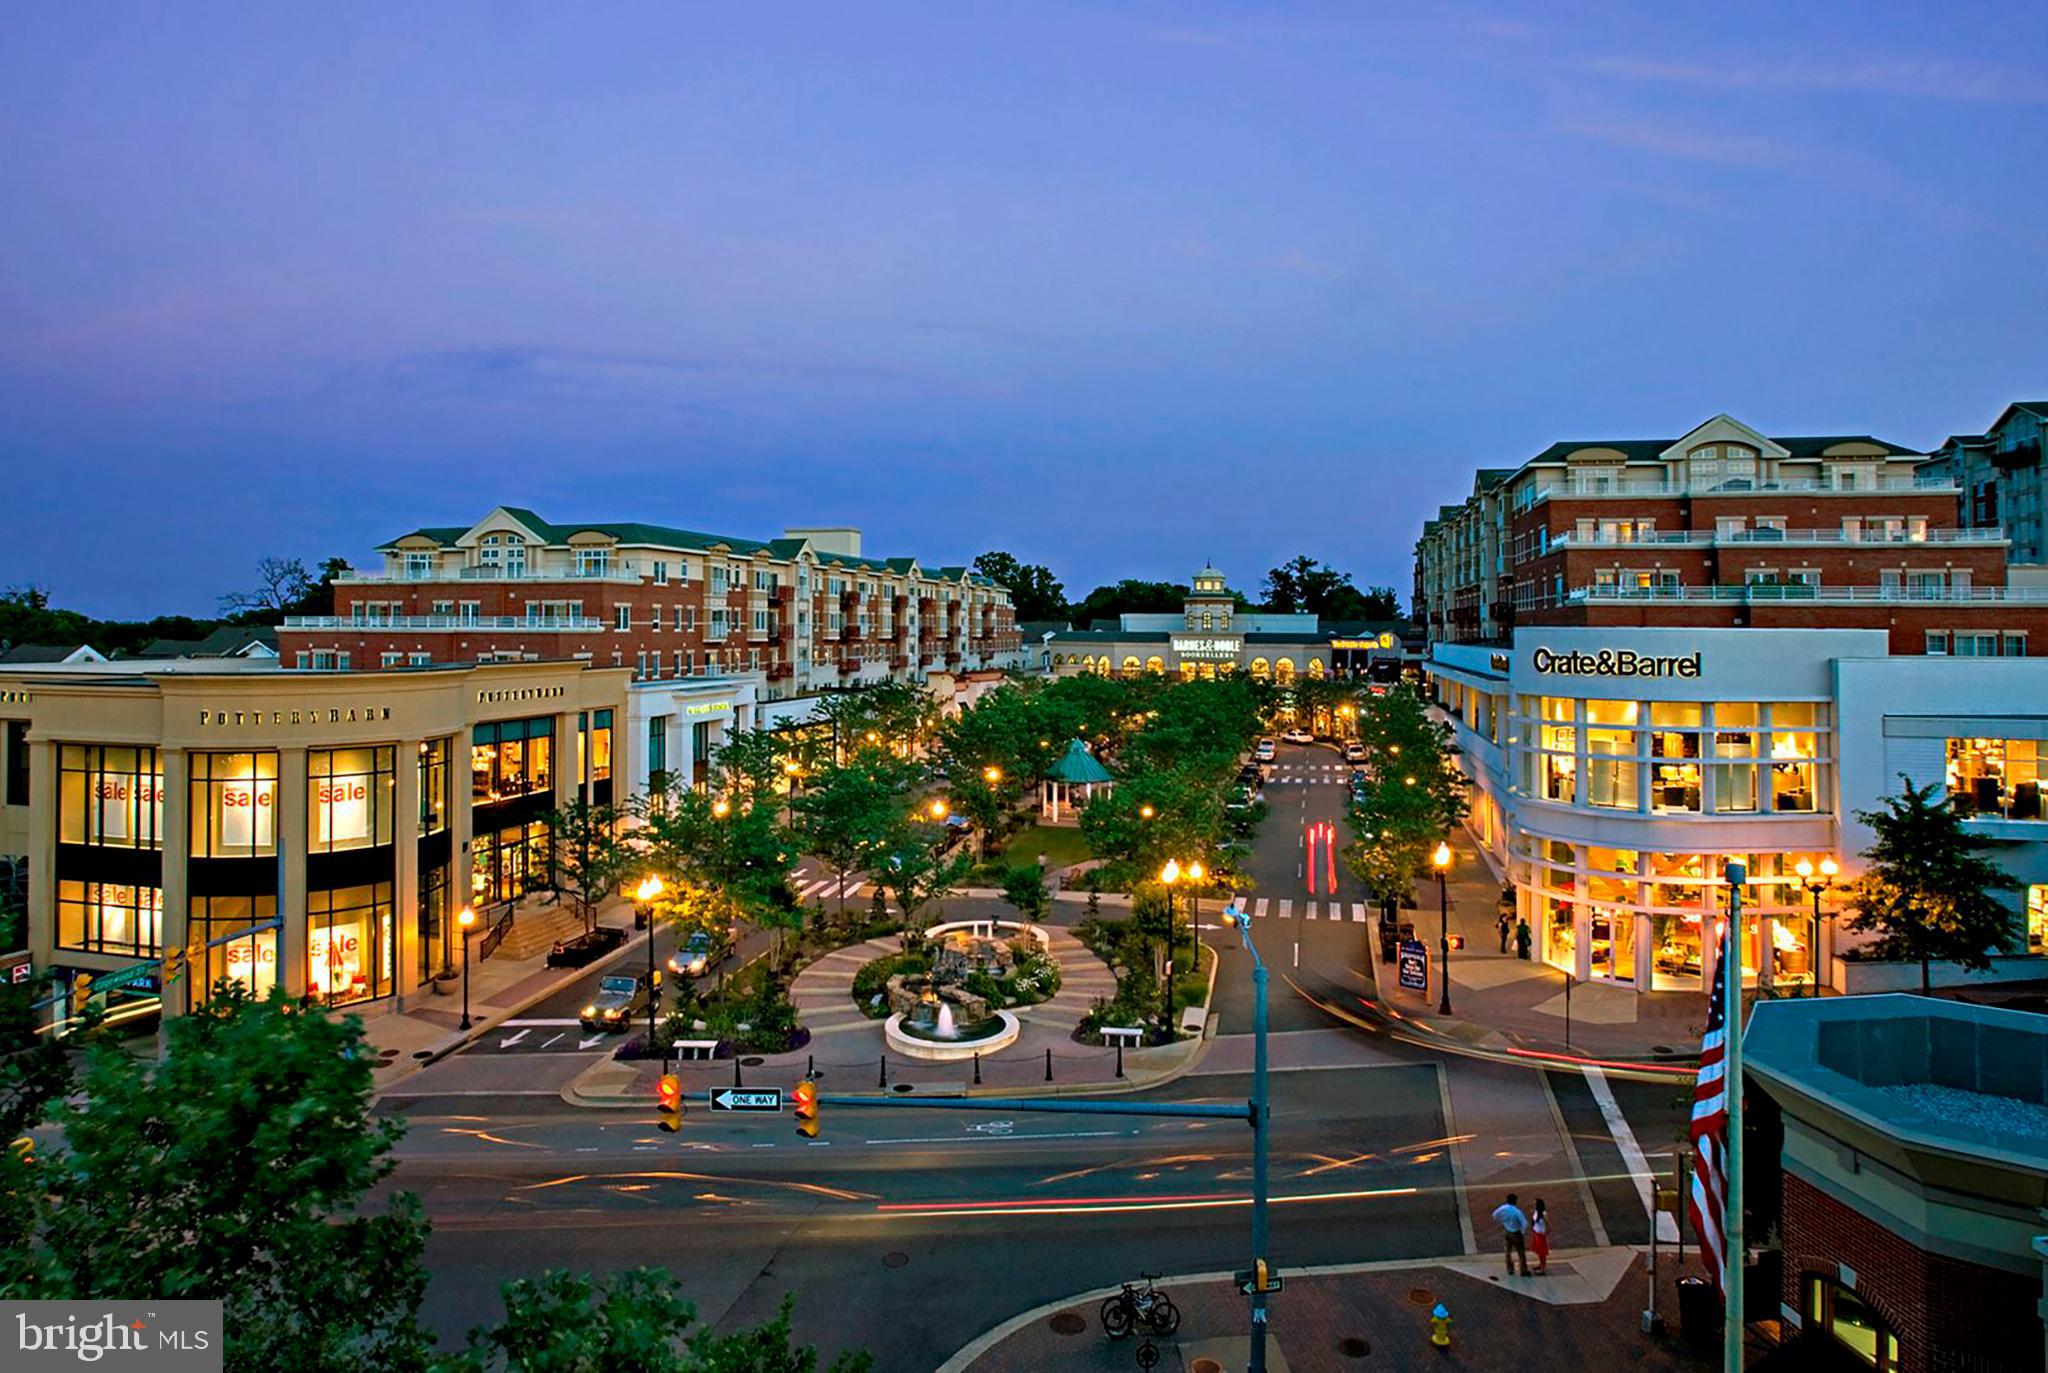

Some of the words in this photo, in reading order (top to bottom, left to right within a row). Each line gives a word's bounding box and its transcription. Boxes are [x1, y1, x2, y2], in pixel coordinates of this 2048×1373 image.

[94, 781, 127, 800] sale
[134, 786, 163, 803] ae
[224, 792, 270, 806] sae
[319, 782, 365, 803] sale
[228, 943, 275, 964] sale
[733, 1094, 752, 1104] ONE
[755, 1094, 775, 1104] WAY
